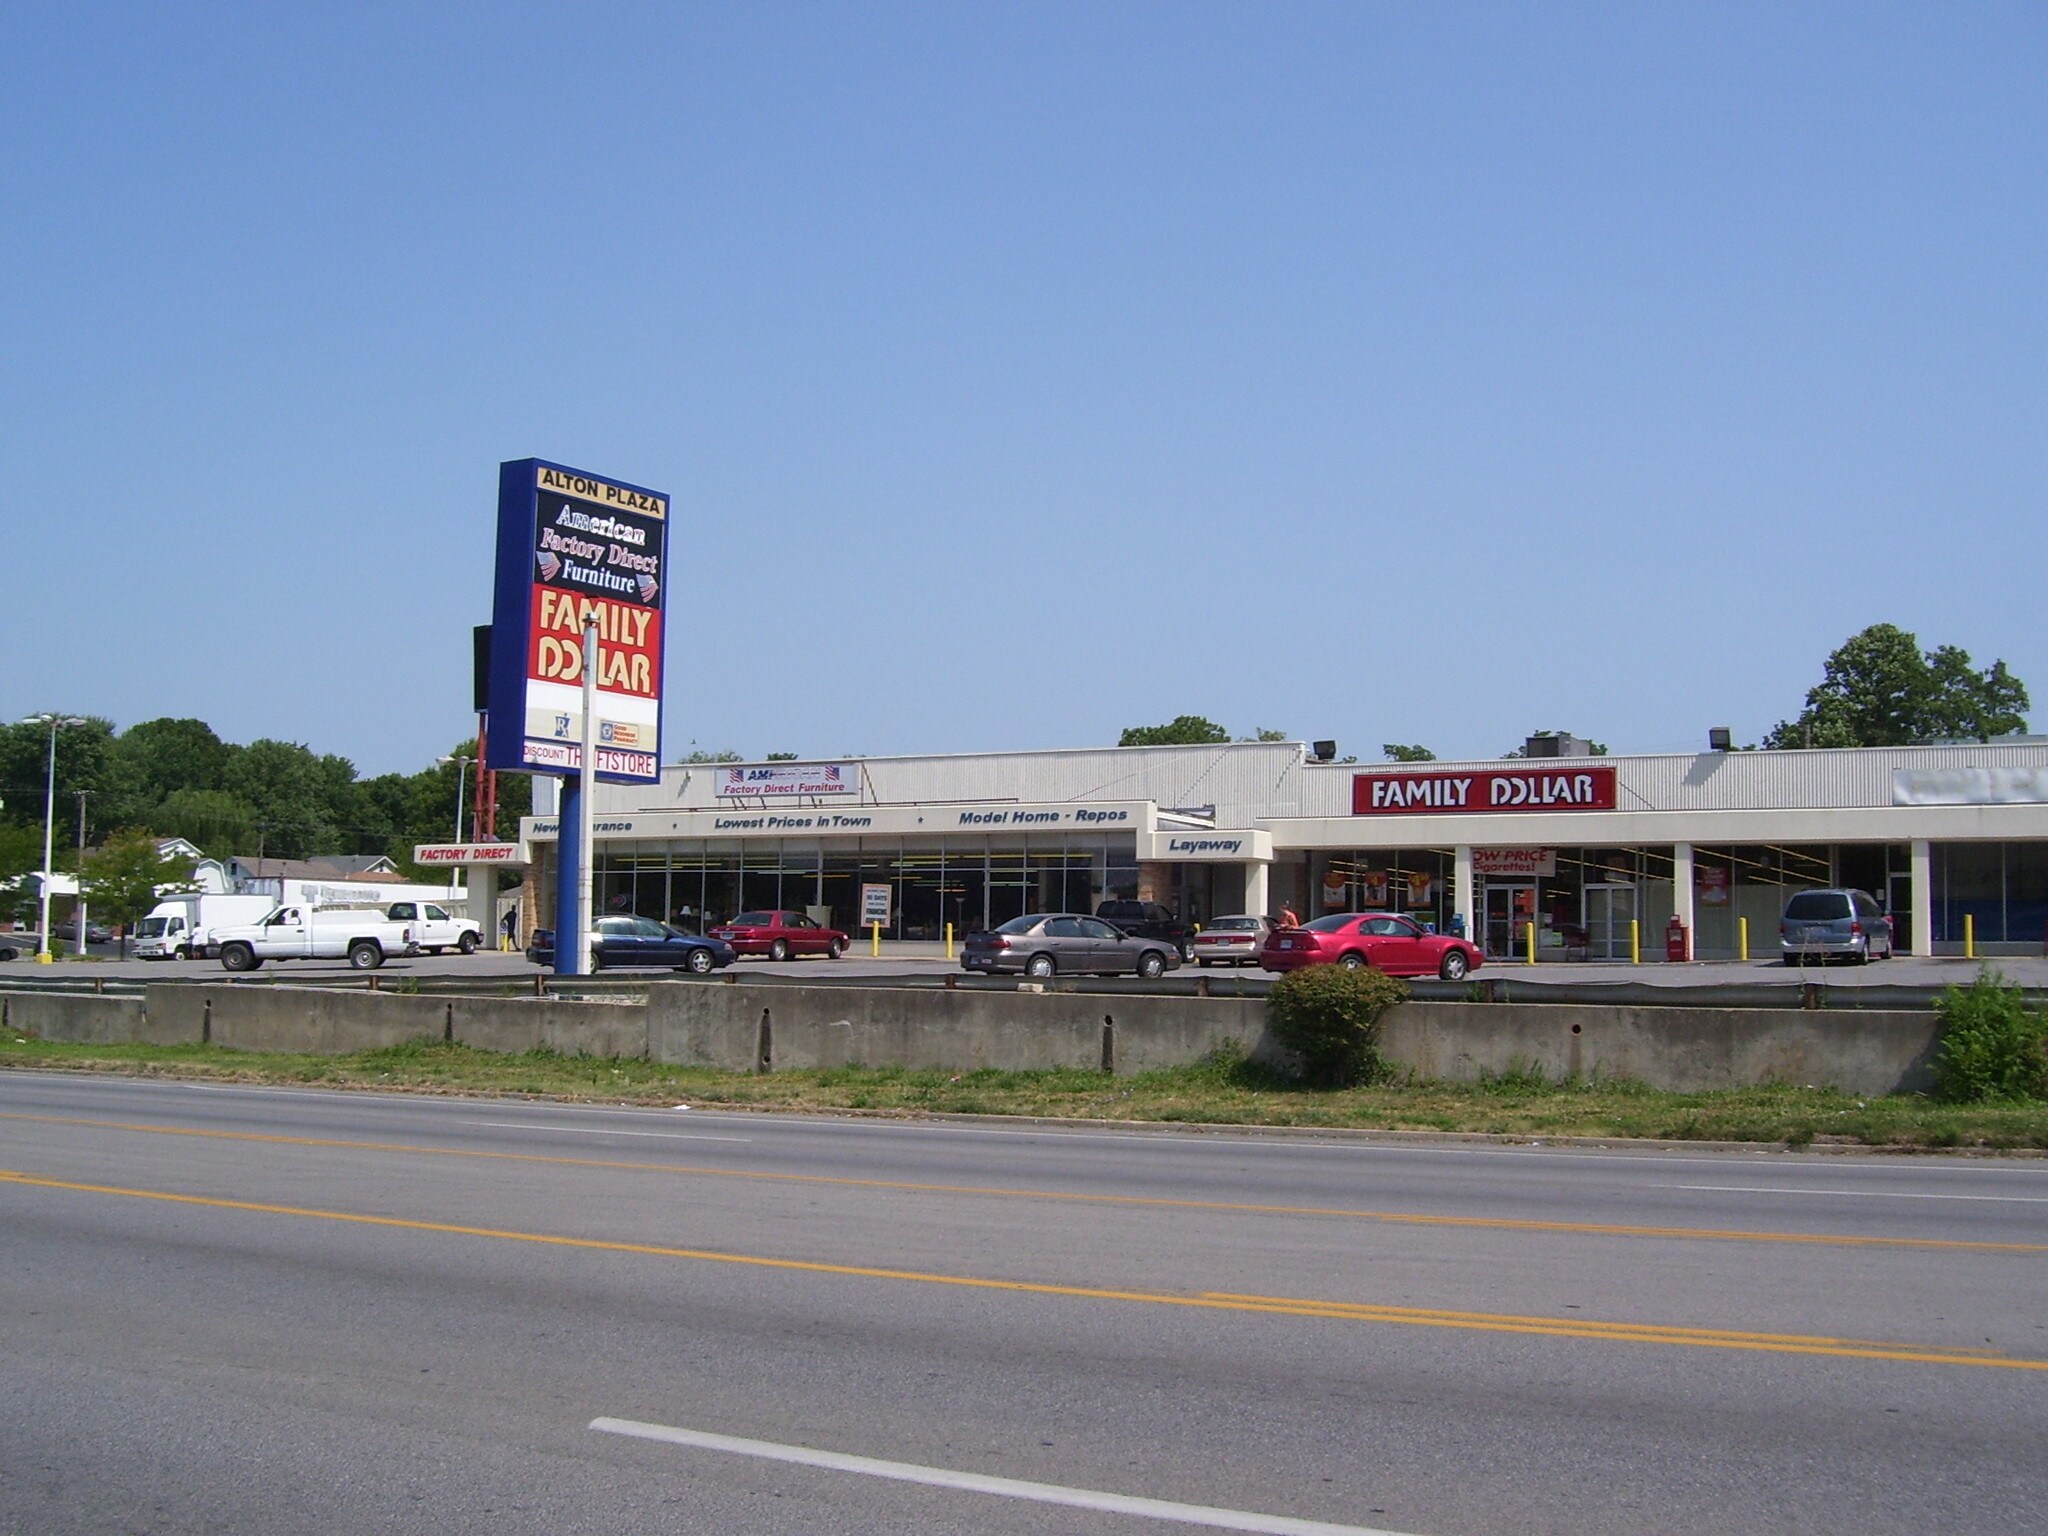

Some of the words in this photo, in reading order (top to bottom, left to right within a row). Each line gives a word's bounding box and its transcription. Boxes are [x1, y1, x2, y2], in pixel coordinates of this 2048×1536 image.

[542, 469, 598, 497] ALTON
[606, 485, 660, 514] PLAZA
[556, 504, 646, 546] American
[540, 527, 606, 566] Factory
[607, 543, 658, 574] Direct
[562, 559, 635, 593] Furniture
[540, 589, 652, 647] FAMILY
[538, 635, 651, 694] DOLAR
[524, 745, 564, 760] DISCOUNT
[724, 785, 760, 796] Factory
[764, 783, 794, 793] Direct
[798, 782, 845, 792] Furniture
[1372, 778, 1472, 808] FAMILY
[1490, 774, 1593, 805] DOLLAR
[715, 818, 763, 829] Lowest
[768, 816, 812, 828] Prices
[817, 816, 829, 827] in
[833, 816, 871, 827] Town
[959, 812, 1007, 824] Model
[1012, 811, 1059, 823] Home
[1075, 809, 1127, 823] Repos
[420, 849, 467, 860] FACTORY
[473, 848, 512, 859] DIRECT
[1169, 838, 1242, 854] Layaway
[1472, 849, 1500, 860] OW
[1504, 850, 1547, 861] PRICE
